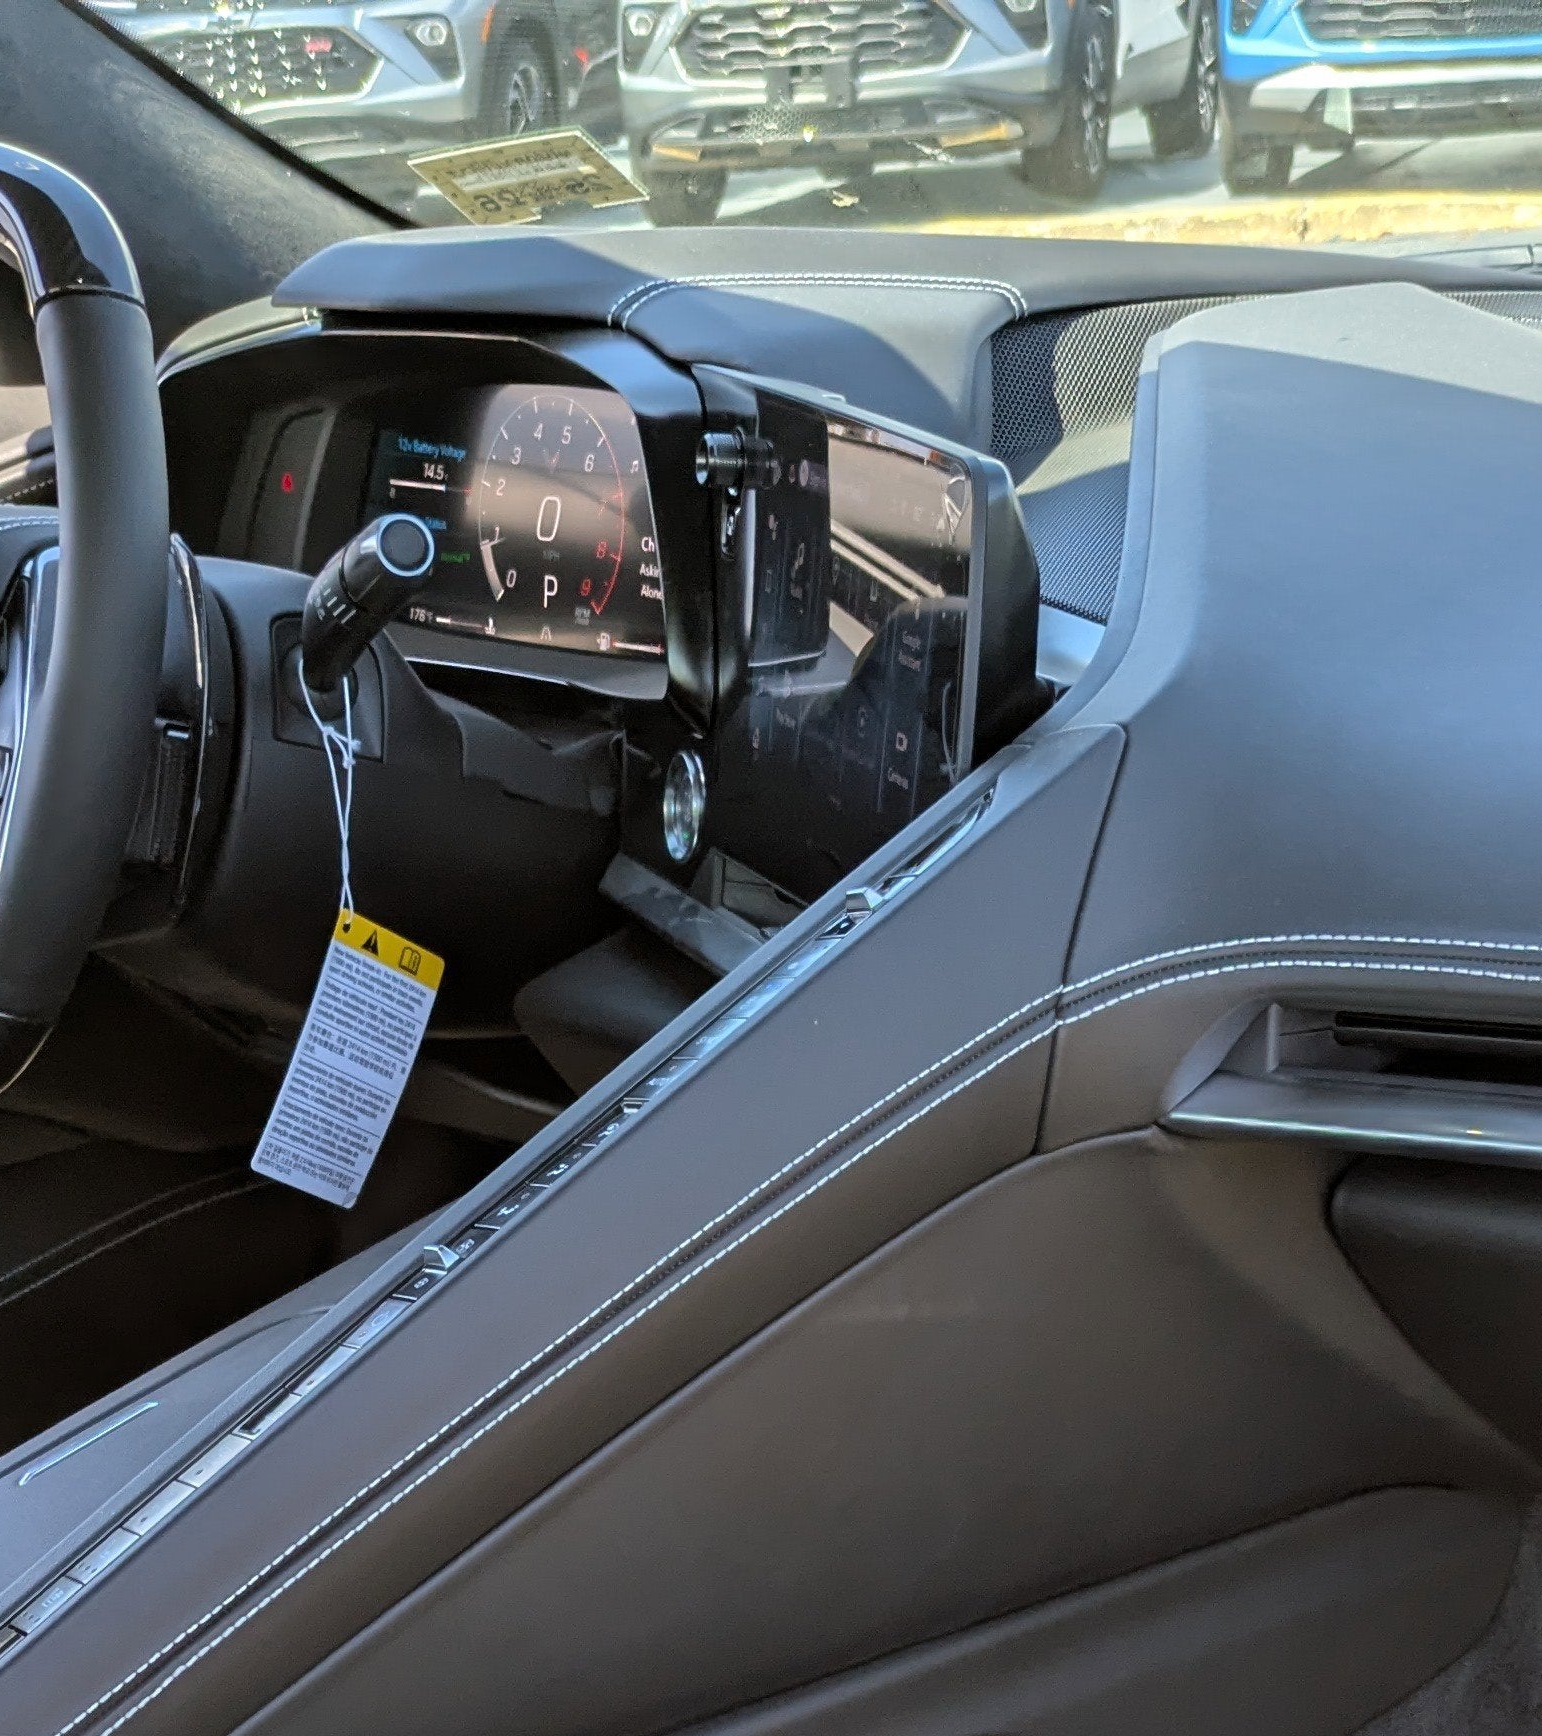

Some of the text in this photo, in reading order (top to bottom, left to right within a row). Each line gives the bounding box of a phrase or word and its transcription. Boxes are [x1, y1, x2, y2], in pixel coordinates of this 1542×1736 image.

[533, 423, 544, 441] 4
[561, 425, 573, 445] 5
[511, 446, 523, 466] 3
[584, 453, 596, 473] 6
[495, 478, 506, 497] 2
[536, 496, 562, 542] 0
[506, 568, 518, 589] 0
[580, 576, 592, 597] 9
[543, 574, 559, 609] P
